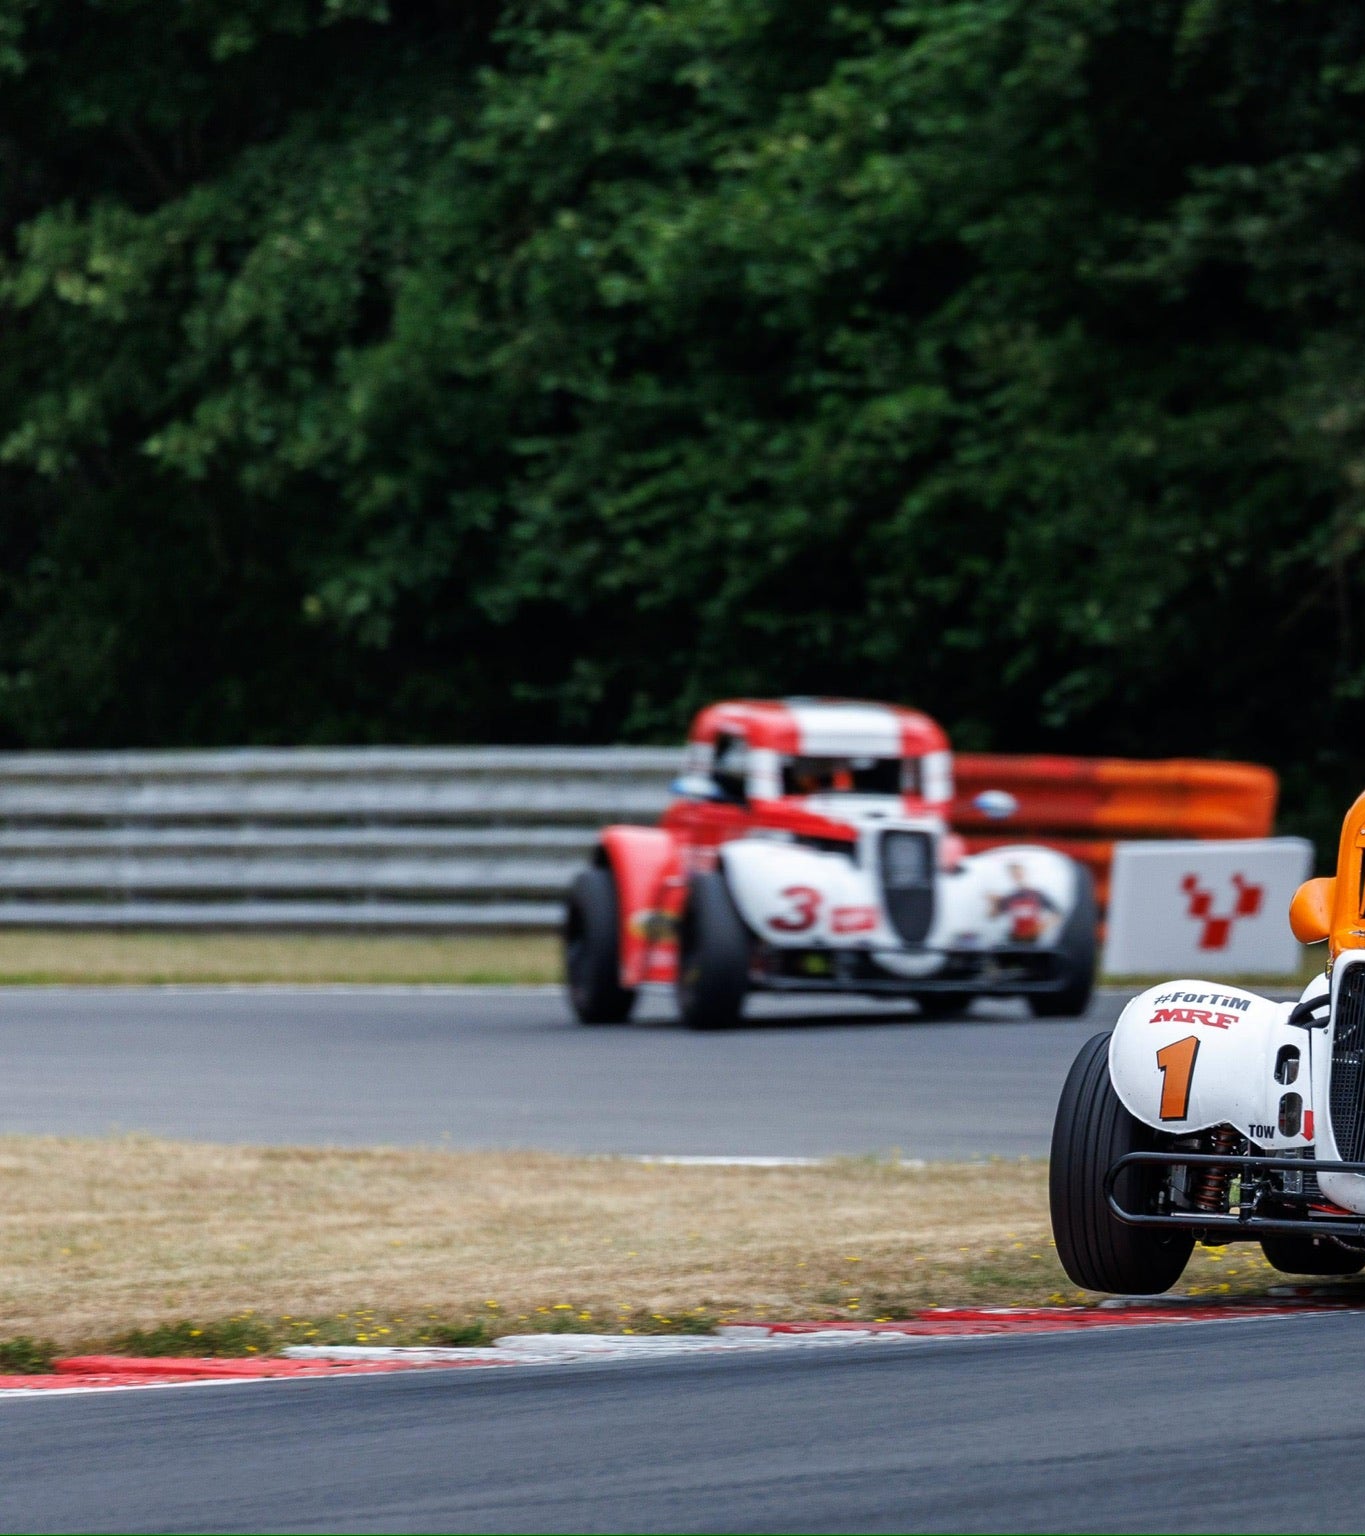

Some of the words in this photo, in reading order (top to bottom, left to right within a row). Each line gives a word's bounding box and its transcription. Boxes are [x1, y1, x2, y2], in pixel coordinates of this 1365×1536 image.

[768, 886, 822, 933] 3
[1154, 991, 1251, 1012] #ForTiM
[1149, 1008, 1239, 1030] MRF
[1156, 1035, 1201, 1121] 1
[1249, 1124, 1276, 1139] TOW
